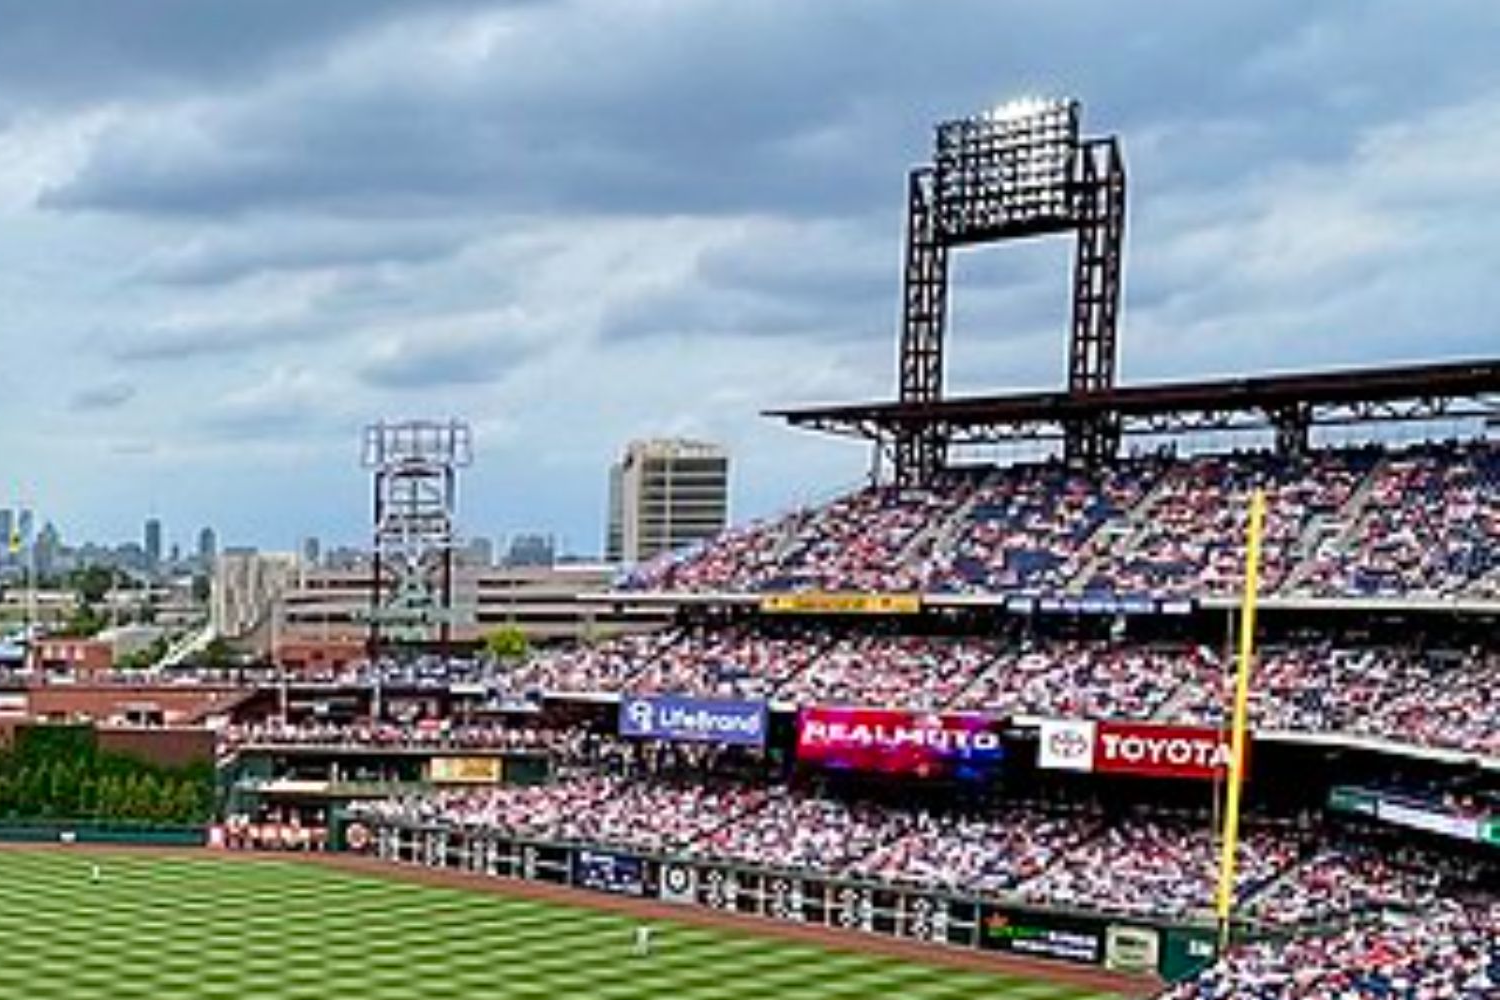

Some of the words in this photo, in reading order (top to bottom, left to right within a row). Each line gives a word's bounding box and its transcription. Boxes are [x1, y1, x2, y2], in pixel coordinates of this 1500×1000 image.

[660, 709, 761, 733] LifeBrand
[803, 719, 999, 750] REALMUTO
[1101, 734, 1232, 767] TOYOTA
